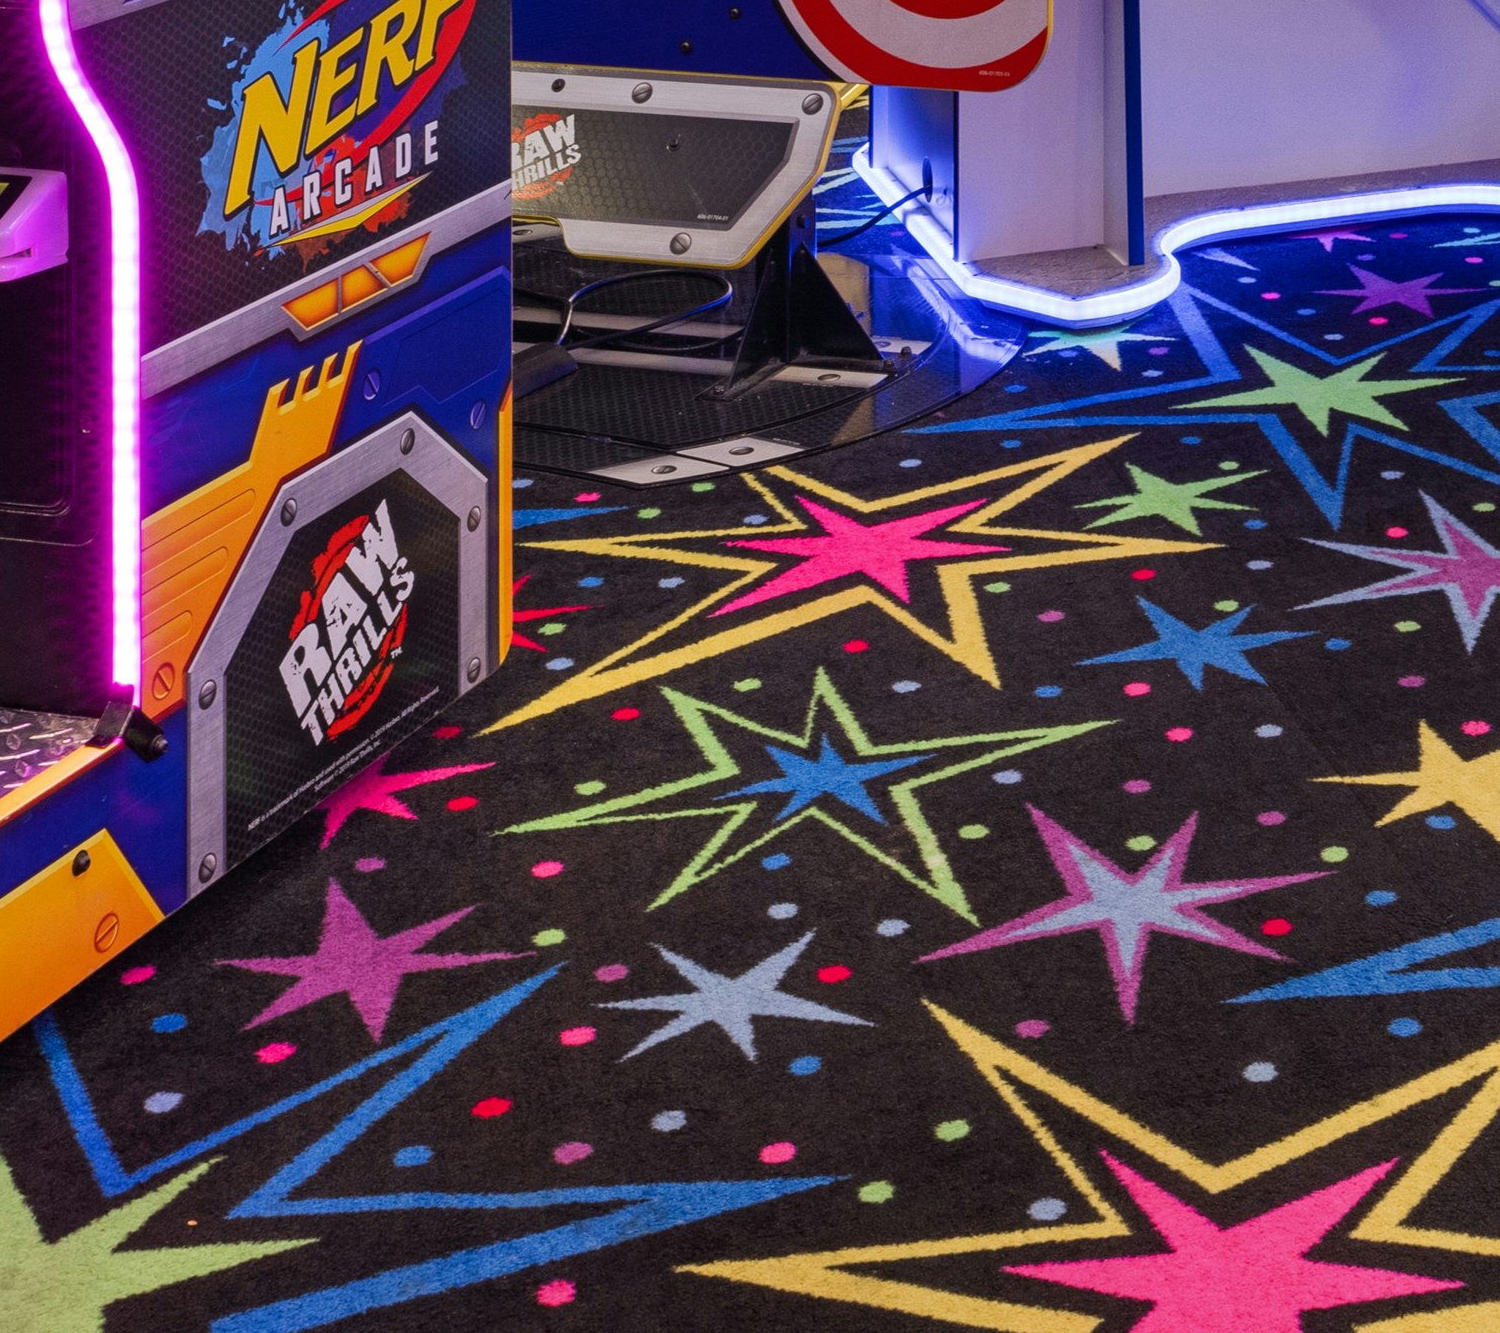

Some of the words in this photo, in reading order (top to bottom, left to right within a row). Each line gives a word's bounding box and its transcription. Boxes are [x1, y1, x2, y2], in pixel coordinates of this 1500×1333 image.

[267, 126, 441, 240] ARCADE
[279, 498, 400, 719] RAW
[300, 555, 415, 747] THRILLS
